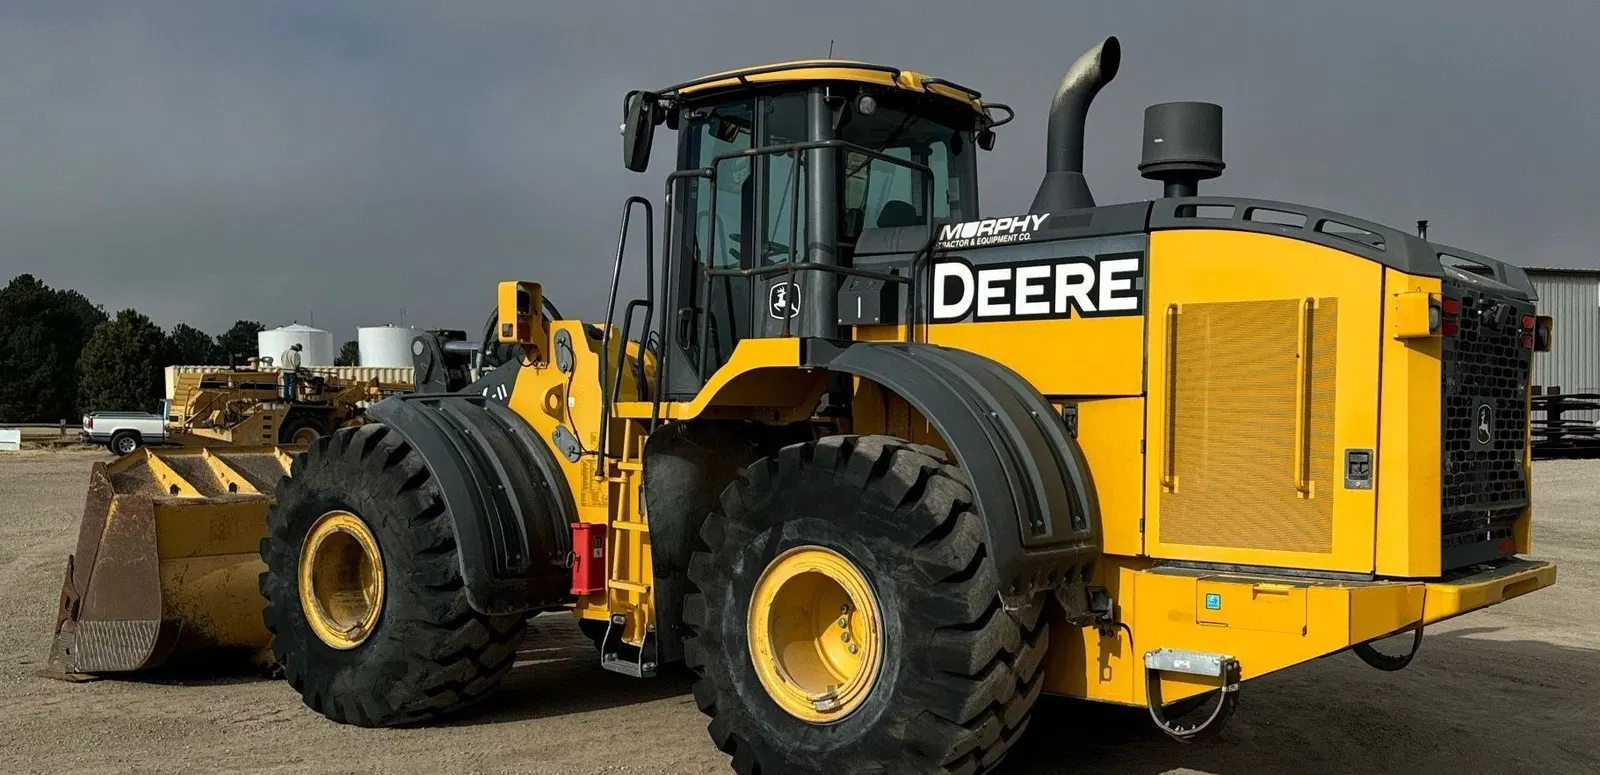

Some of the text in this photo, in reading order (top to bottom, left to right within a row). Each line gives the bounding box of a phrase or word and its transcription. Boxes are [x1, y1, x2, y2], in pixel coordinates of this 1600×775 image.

[970, 238, 975, 246] &
[976, 233, 1017, 245] EQUIPMENT
[1018, 232, 1032, 241] CO.
[933, 258, 1139, 319] DEERE
